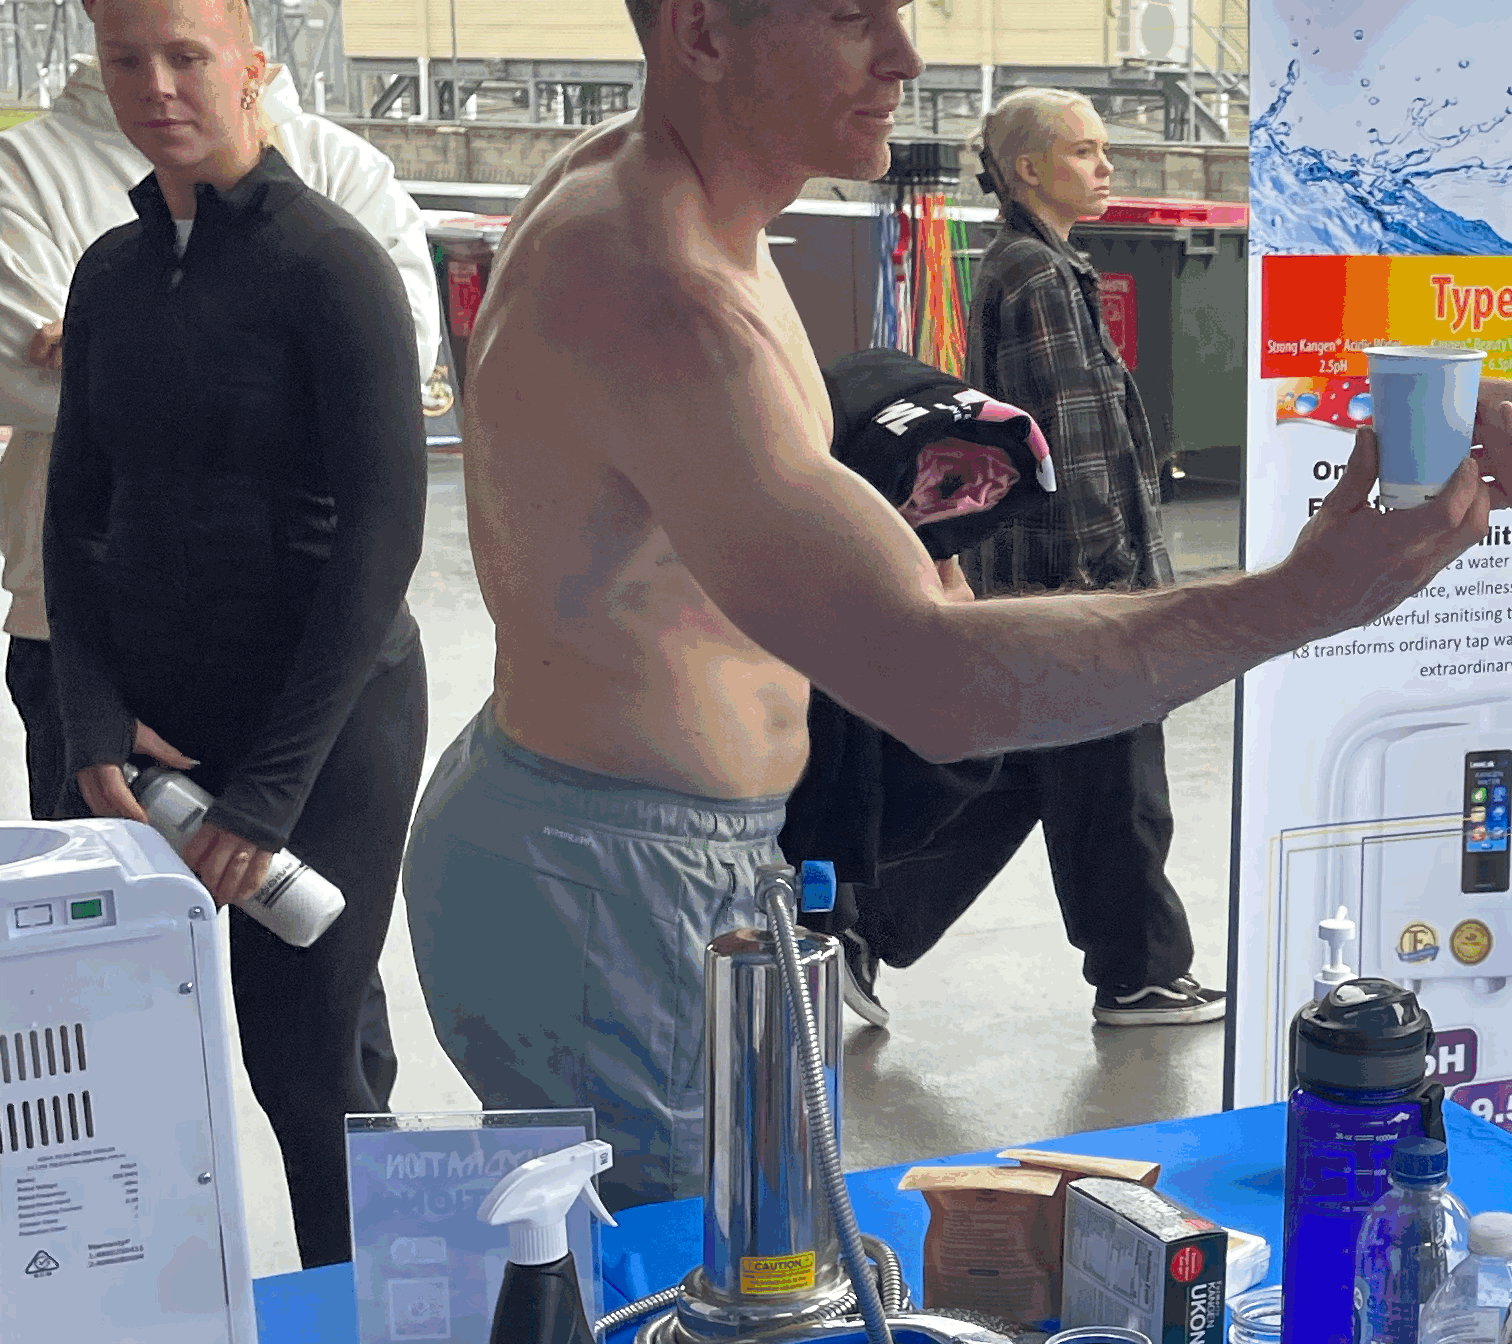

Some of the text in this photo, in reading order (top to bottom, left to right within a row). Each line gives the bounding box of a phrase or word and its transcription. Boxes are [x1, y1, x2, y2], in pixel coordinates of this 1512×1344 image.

[1319, 359, 1348, 375] 2.5pH
[1468, 557, 1510, 570] water
[1364, 611, 1430, 631] owerful
[1435, 607, 1502, 626] sanitising
[1314, 639, 1395, 658] transforms
[1399, 634, 1461, 657] ordinary
[1466, 634, 1490, 650] tap
[754, 1260, 802, 1271] CAUTION
